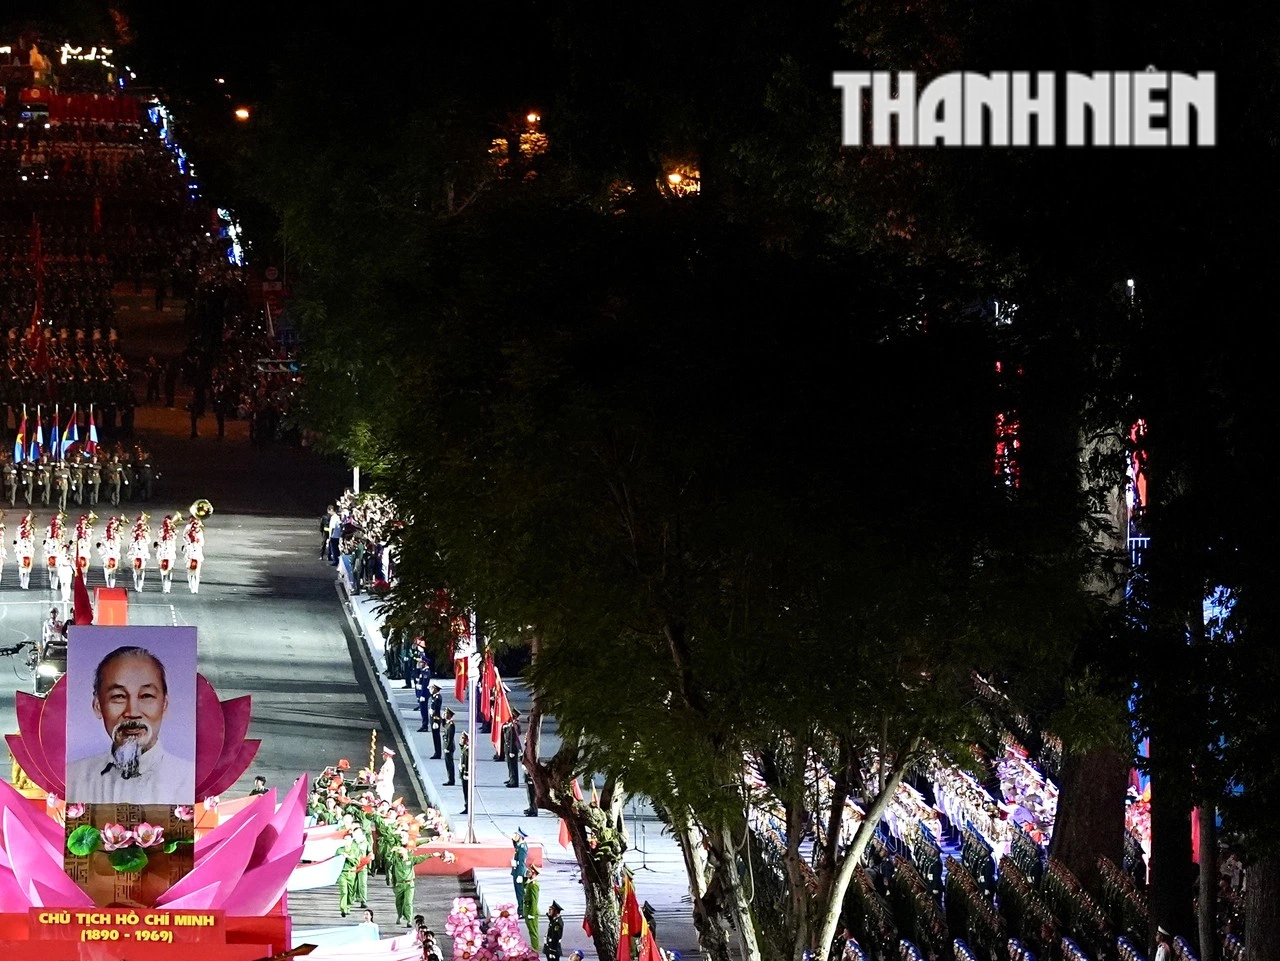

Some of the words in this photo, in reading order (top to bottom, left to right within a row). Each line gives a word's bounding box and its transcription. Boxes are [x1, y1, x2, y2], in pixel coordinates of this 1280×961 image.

[39, 910, 71, 924] CHỦ
[75, 913, 112, 927] TỊCH
[115, 910, 140, 925] HỒ
[144, 912, 170, 926] CHÍ
[174, 915, 216, 926] MINH
[81, 929, 120, 942] (1890
[134, 930, 174, 943] 1969)
